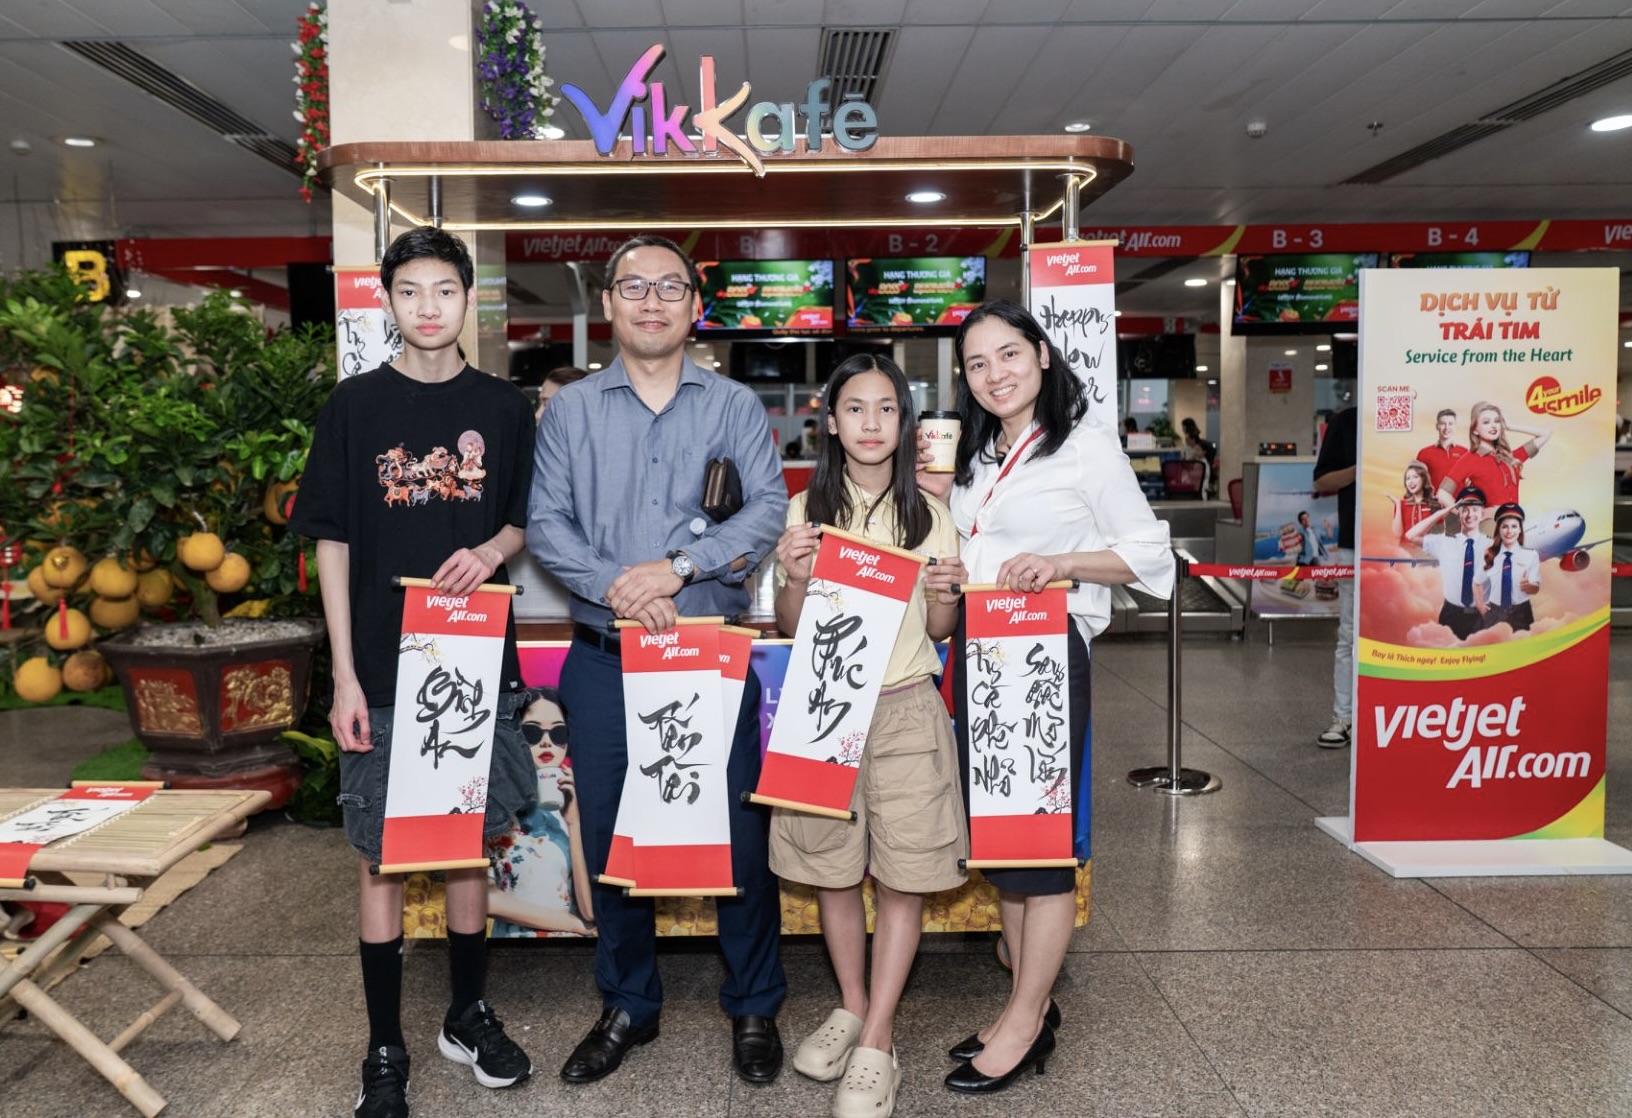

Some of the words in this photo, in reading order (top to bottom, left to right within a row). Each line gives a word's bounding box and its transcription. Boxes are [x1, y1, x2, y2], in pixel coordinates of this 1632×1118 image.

[1272, 229, 1287, 248] B
[1309, 229, 1323, 248] 3
[1428, 227, 1442, 246] B
[1464, 227, 1479, 246] 4
[65, 249, 110, 301] B
[1065, 264, 1097, 276] Air.com
[1420, 291, 1479, 316] DỊCH
[1485, 291, 1518, 316] VỤ
[1439, 317, 1493, 340] TRÁI
[1499, 321, 1540, 340] TIM
[1405, 348, 1457, 364] Service
[1461, 348, 1498, 366] from
[1502, 348, 1526, 363] the
[1530, 348, 1573, 363] Heart
[1546, 384, 1602, 412] smile
[855, 565, 896, 584] Air.com
[447, 610, 487, 623] Air.com
[1009, 610, 1047, 624] Air.com
[662, 646, 699, 660] Air.com
[1372, 649, 1386, 659] Bay
[1445, 745, 1591, 789] Air.com
